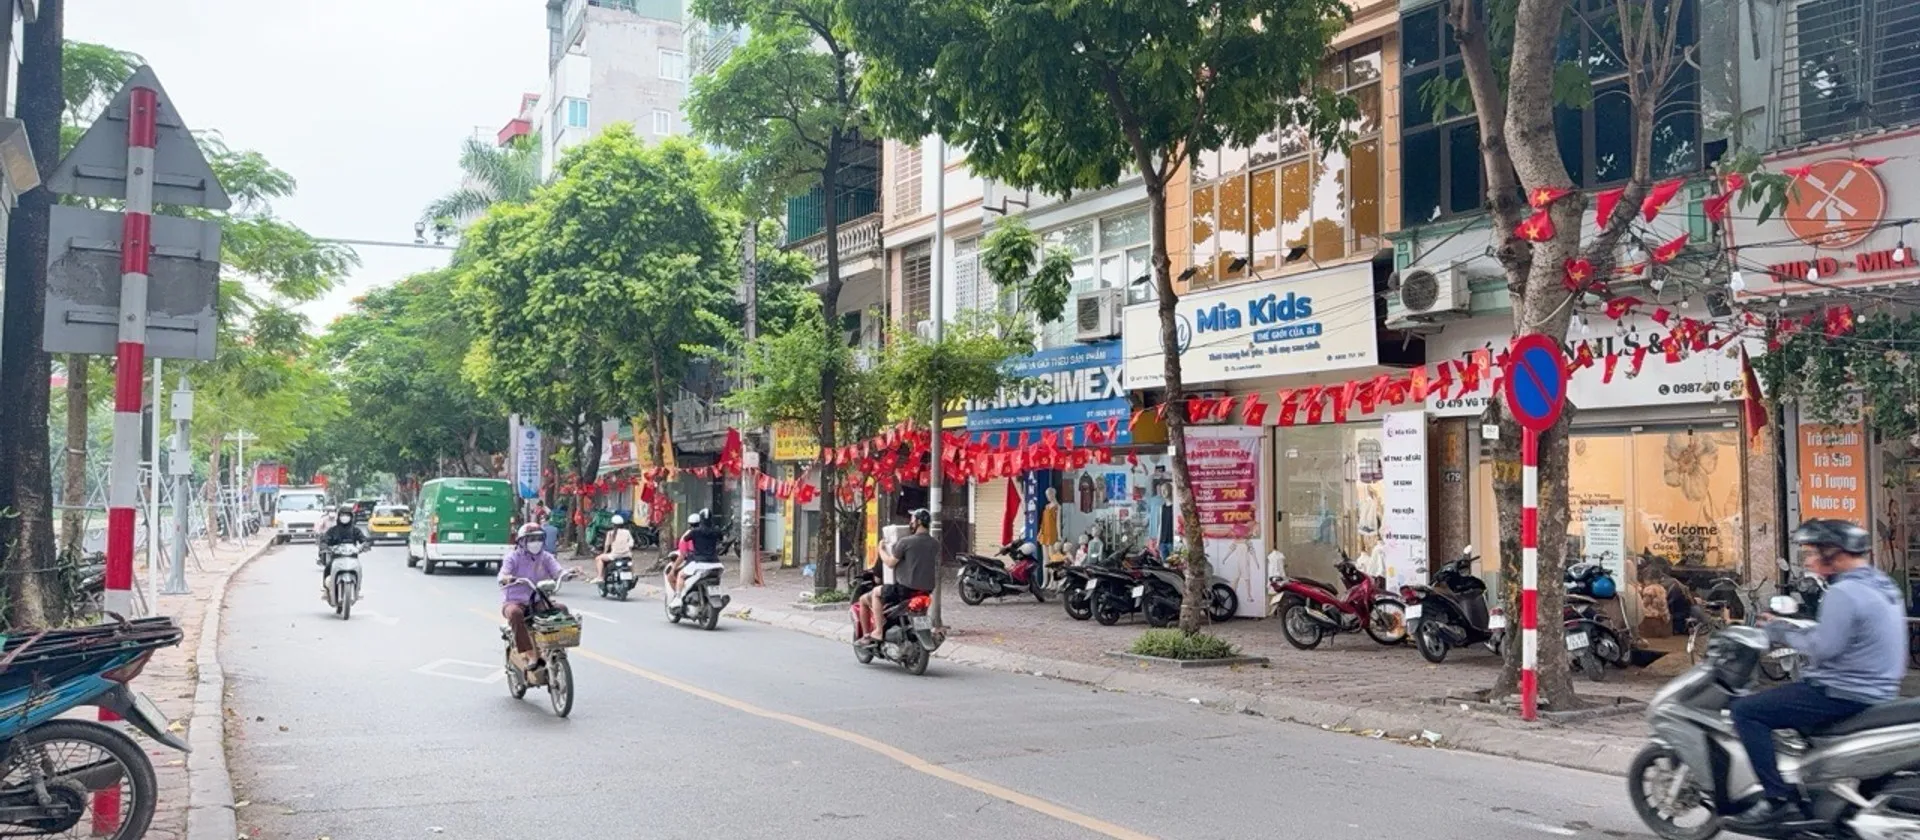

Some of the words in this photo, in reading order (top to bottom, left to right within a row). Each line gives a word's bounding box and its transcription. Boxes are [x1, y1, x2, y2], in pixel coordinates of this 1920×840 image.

[1767, 256, 1838, 282] WIND
[1855, 248, 1917, 273] MILL
[1197, 302, 1242, 333] Mia
[1248, 291, 1312, 326] Kids
[1288, 326, 1305, 338] CỦA
[1648, 332, 1664, 355] &
[966, 363, 1125, 412] NOSIMEX
[1673, 382, 1701, 394] 0987
[1447, 399, 1463, 408] 479
[1466, 397, 1479, 407] Vũ
[1806, 431, 1822, 446] Trà
[1813, 452, 1829, 467] Trà
[1824, 474, 1857, 491] Tượng
[1220, 488, 1247, 499] 70K
[1811, 495, 1840, 510] Nước
[1842, 496, 1856, 512] ép
[1222, 510, 1252, 521] 170K
[1653, 522, 1718, 536] Welcome
